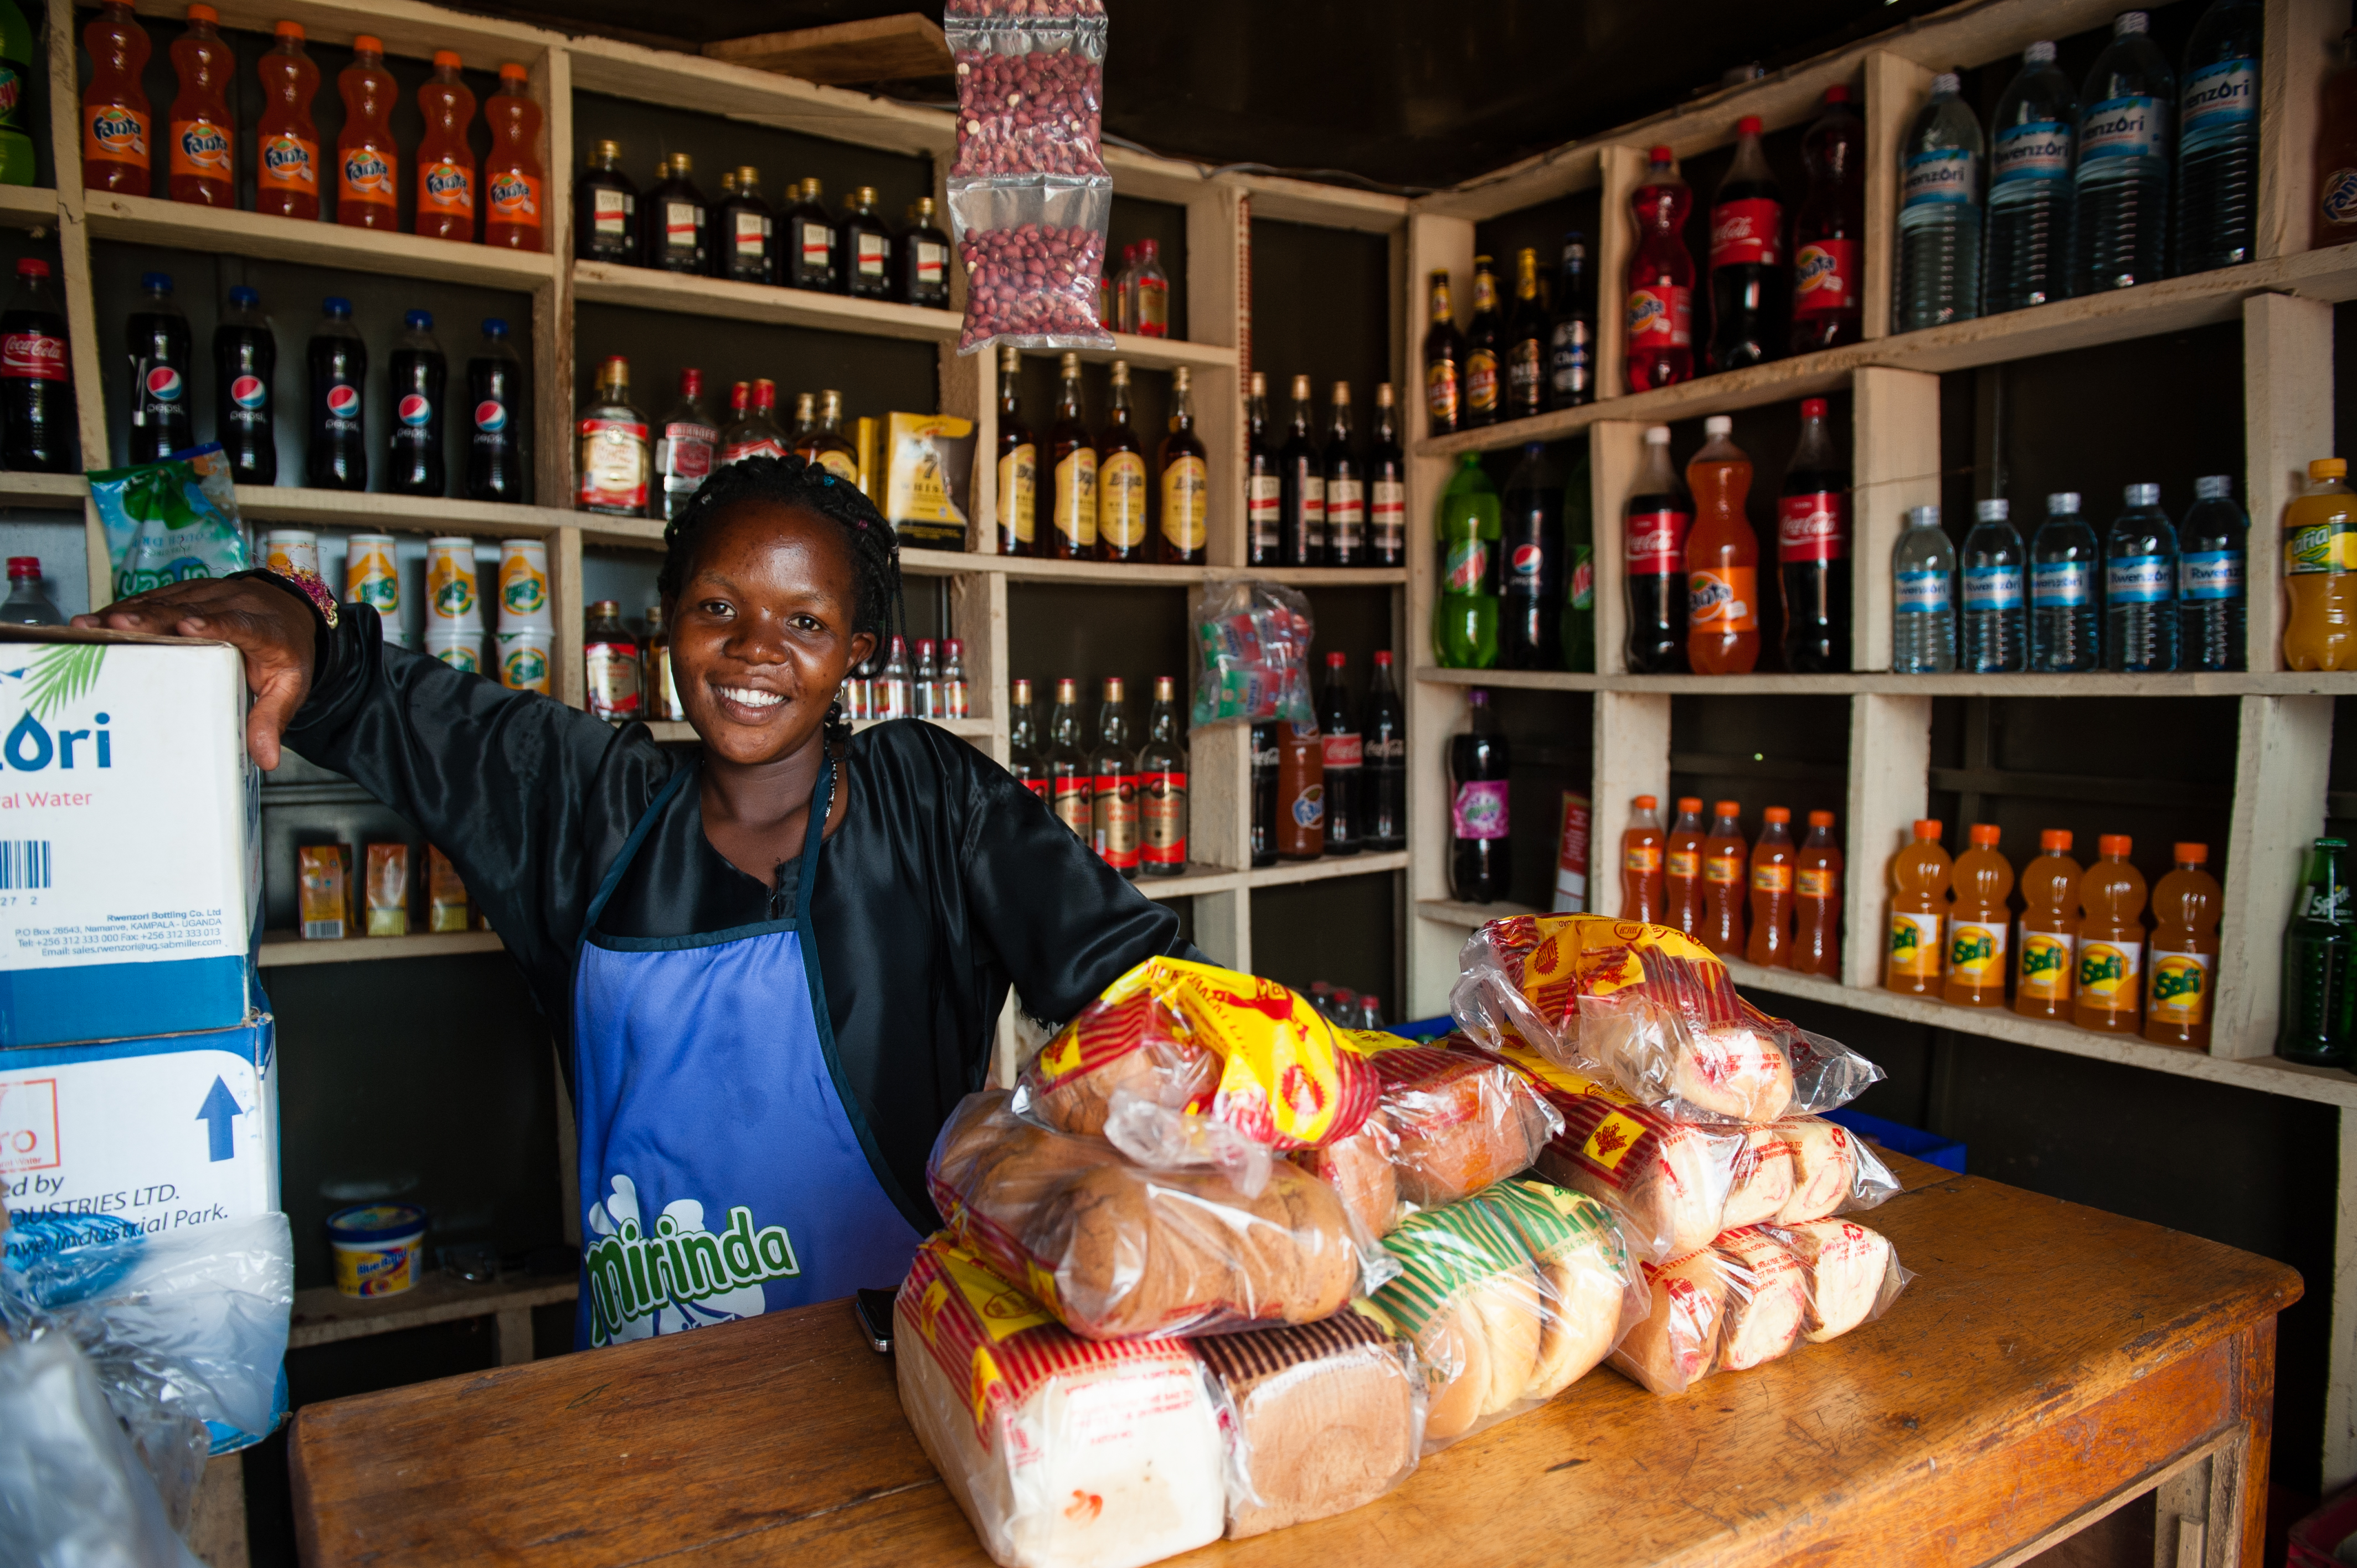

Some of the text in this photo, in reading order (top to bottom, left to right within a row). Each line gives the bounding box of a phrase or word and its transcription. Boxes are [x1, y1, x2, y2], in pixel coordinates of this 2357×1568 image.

[92, 116, 141, 141] Fanta
[181, 131, 227, 156] Fanta
[264, 146, 309, 169] Fanta
[344, 158, 388, 182] Fanta
[425, 172, 467, 194] Fanta
[490, 182, 530, 204] Fanta
[147, 403, 183, 416] pepsi
[230, 411, 264, 423] pepsi
[2293, 528, 2329, 554] afia
[25, 791, 92, 808] Water
[30, 896, 37, 906] 2
[33, 928, 50, 936] Box
[85, 924, 128, 933] Namanve,
[131, 921, 174, 930] KAMPALA
[182, 918, 222, 927] UGANDA
[107, 912, 149, 922] Rwenzori
[152, 911, 187, 920] Bottling
[18, 928, 220, 947] Tel: +256 312 333 000 Fax: +256 312 333 013
[42, 947, 70, 956] Email:
[1952, 937, 1992, 964] Safi
[2023, 947, 2063, 975] Safi
[2080, 956, 2122, 985] Safi
[2154, 968, 2202, 1000] Safi
[35, 1174, 65, 1197] by
[133, 1184, 179, 1207] LTD.
[55, 1213, 168, 1250] Industrial
[174, 1203, 228, 1229] Park.
[357, 1261, 380, 1276] Blue
[584, 1205, 801, 1349] mirinda
